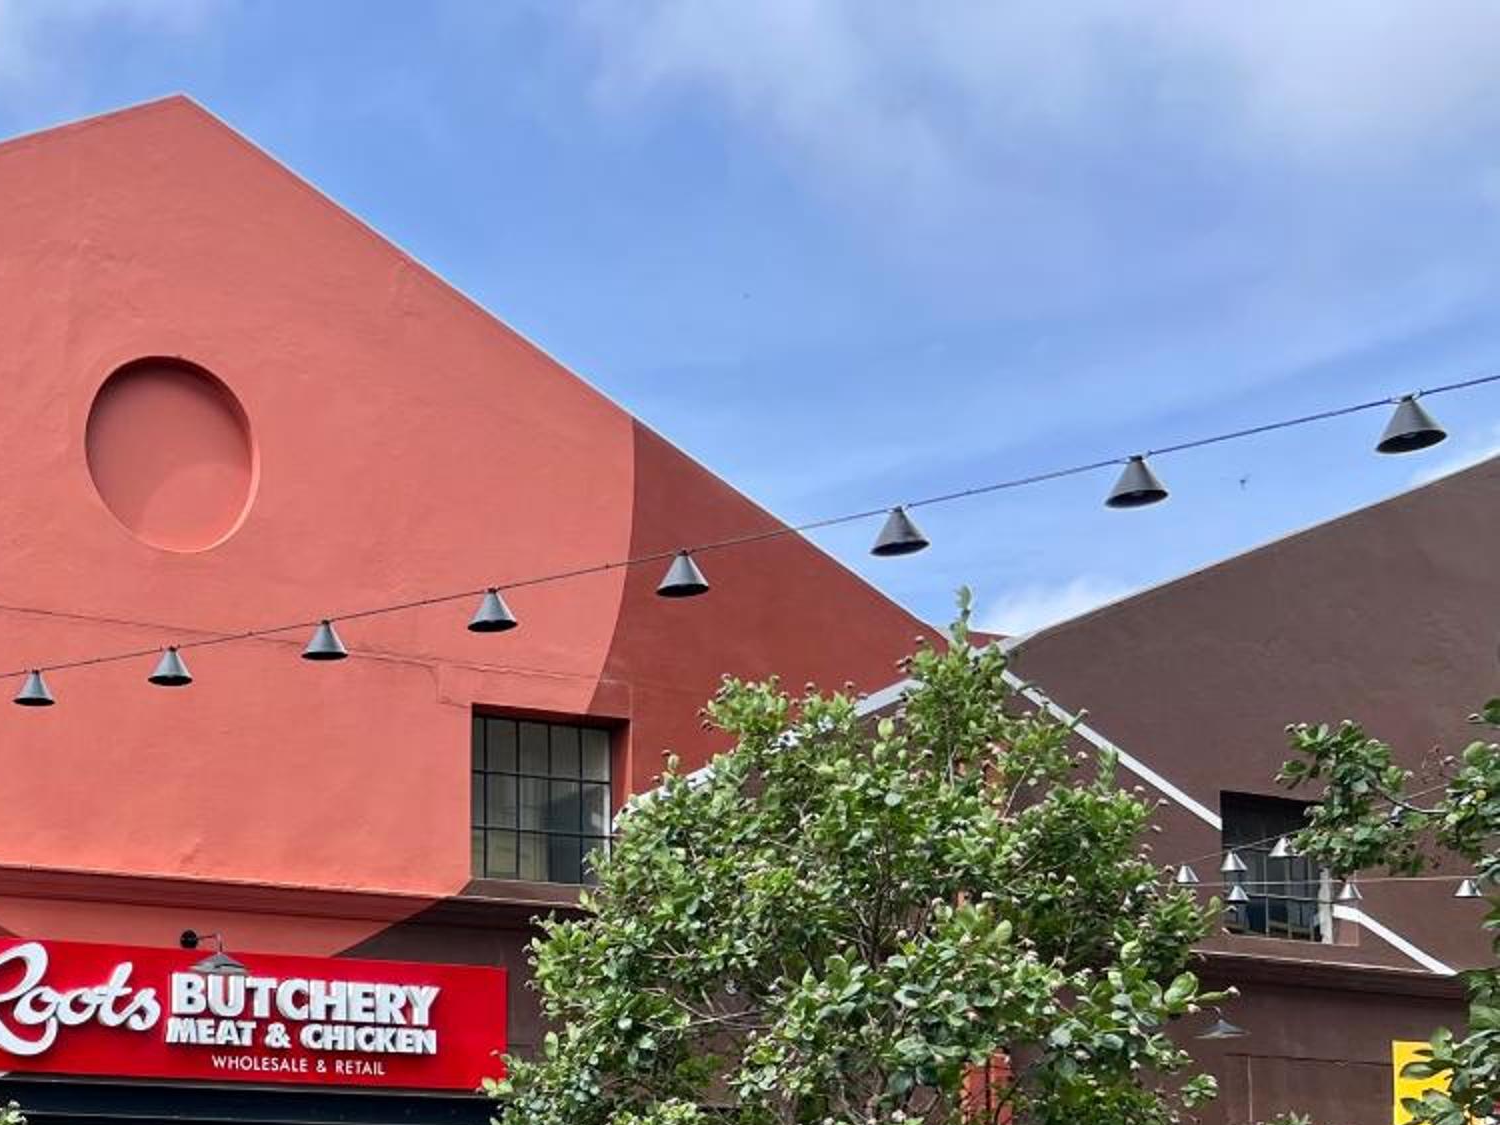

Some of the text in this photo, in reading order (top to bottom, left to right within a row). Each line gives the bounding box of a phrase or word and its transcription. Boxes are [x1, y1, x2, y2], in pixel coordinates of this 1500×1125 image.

[170, 971, 441, 1026] BUTCHERY
[165, 1016, 437, 1055] MEAT & CHICKEN
[211, 1054, 386, 1076] WHOLESALE & RETAIL
